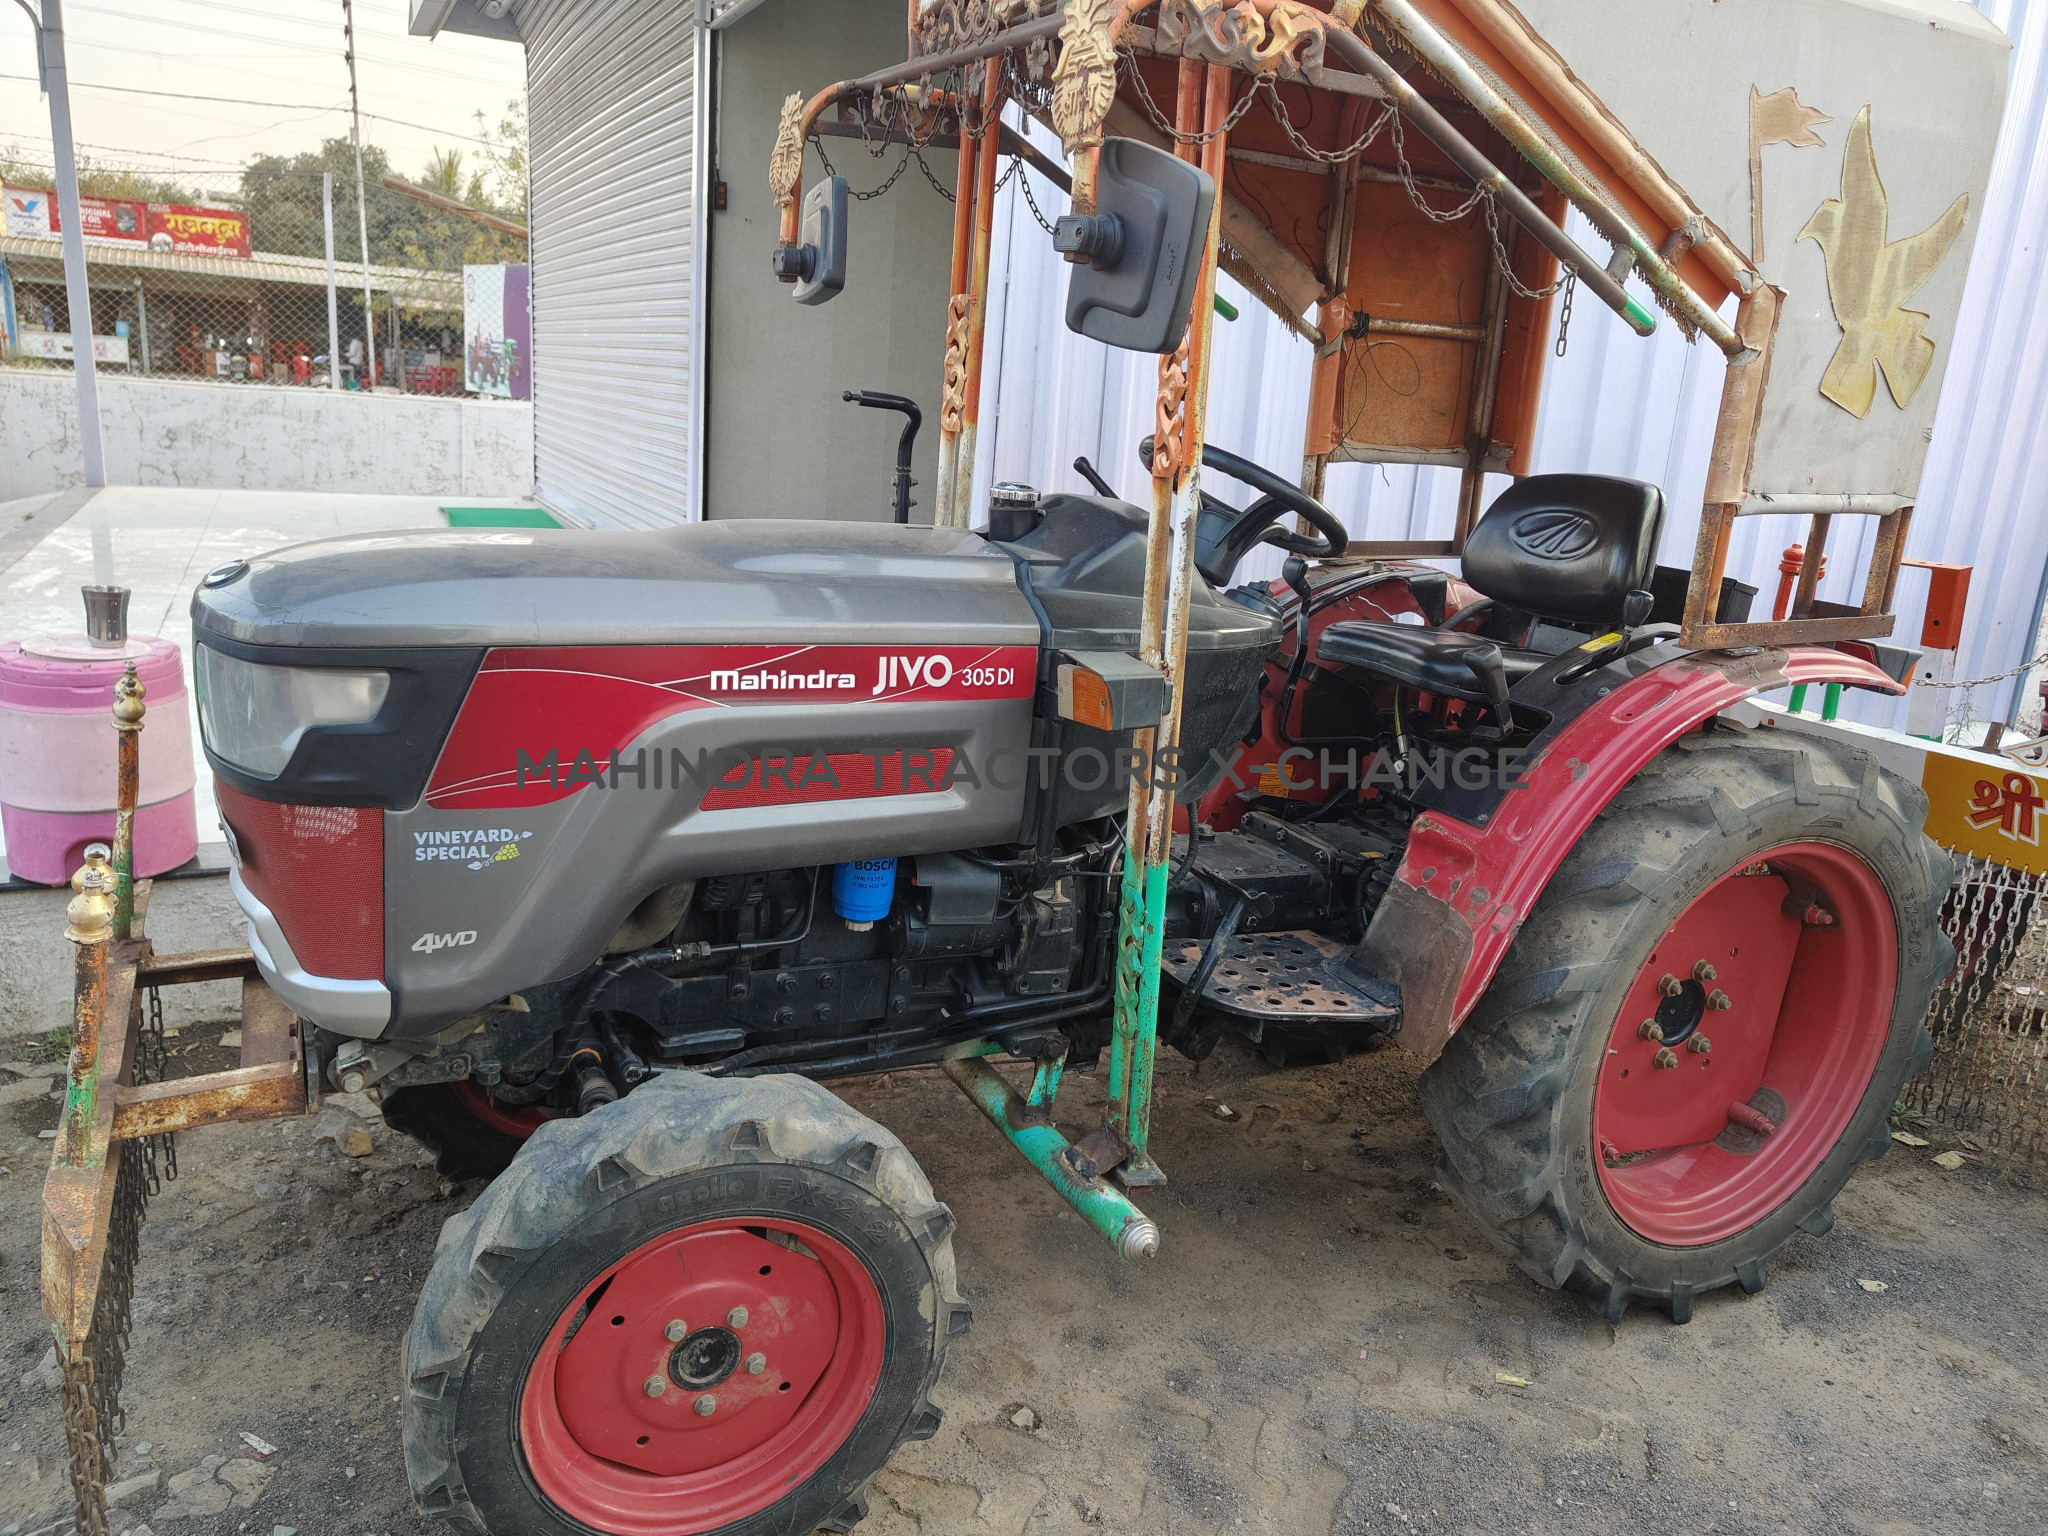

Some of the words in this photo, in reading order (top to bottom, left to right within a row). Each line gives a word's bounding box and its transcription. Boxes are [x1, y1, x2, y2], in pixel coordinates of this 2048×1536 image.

[710, 669, 856, 691] Mahindra
[872, 655, 953, 696] JIVO
[1966, 773, 2046, 842] श्री
[413, 828, 514, 845] VINEYARD
[415, 845, 490, 861] SPECIAL
[854, 858, 895, 872] BOSCH
[411, 930, 477, 954] 4WD
[657, 1173, 746, 1213] apollo
